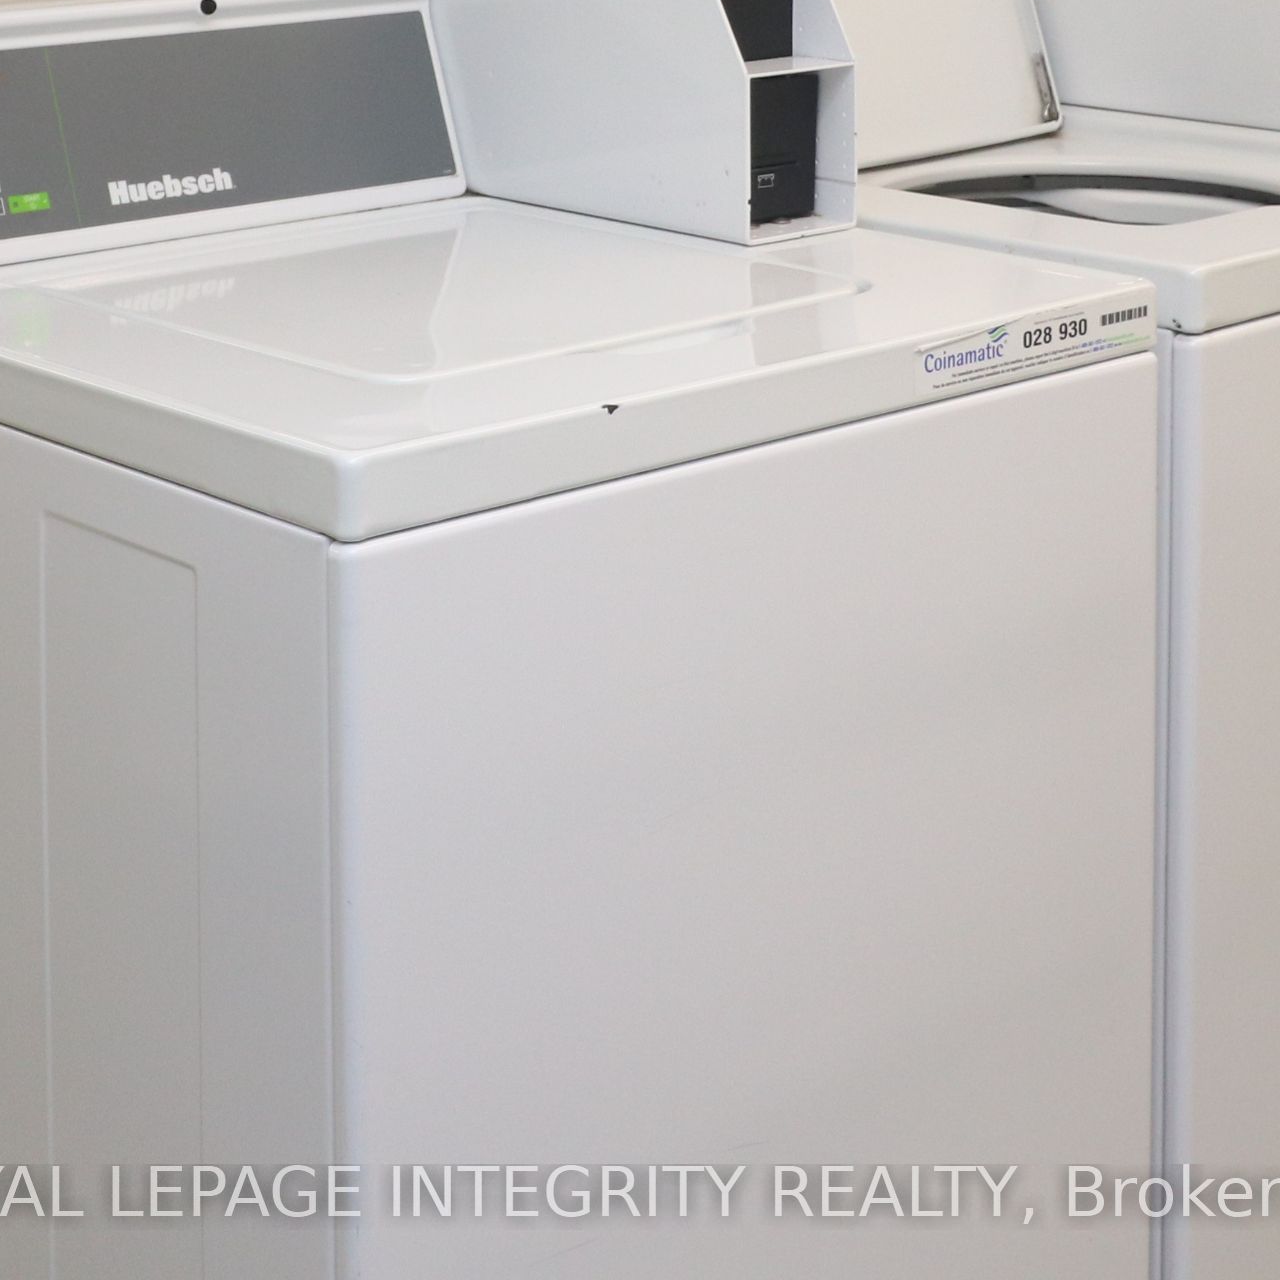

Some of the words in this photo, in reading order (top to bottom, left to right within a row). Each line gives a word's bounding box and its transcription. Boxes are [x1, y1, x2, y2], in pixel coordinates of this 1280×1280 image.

[107, 167, 233, 206] Huebsch
[924, 341, 1004, 373] Coinamatic
[1023, 326, 1052, 348] 028
[1059, 318, 1087, 340] 930
